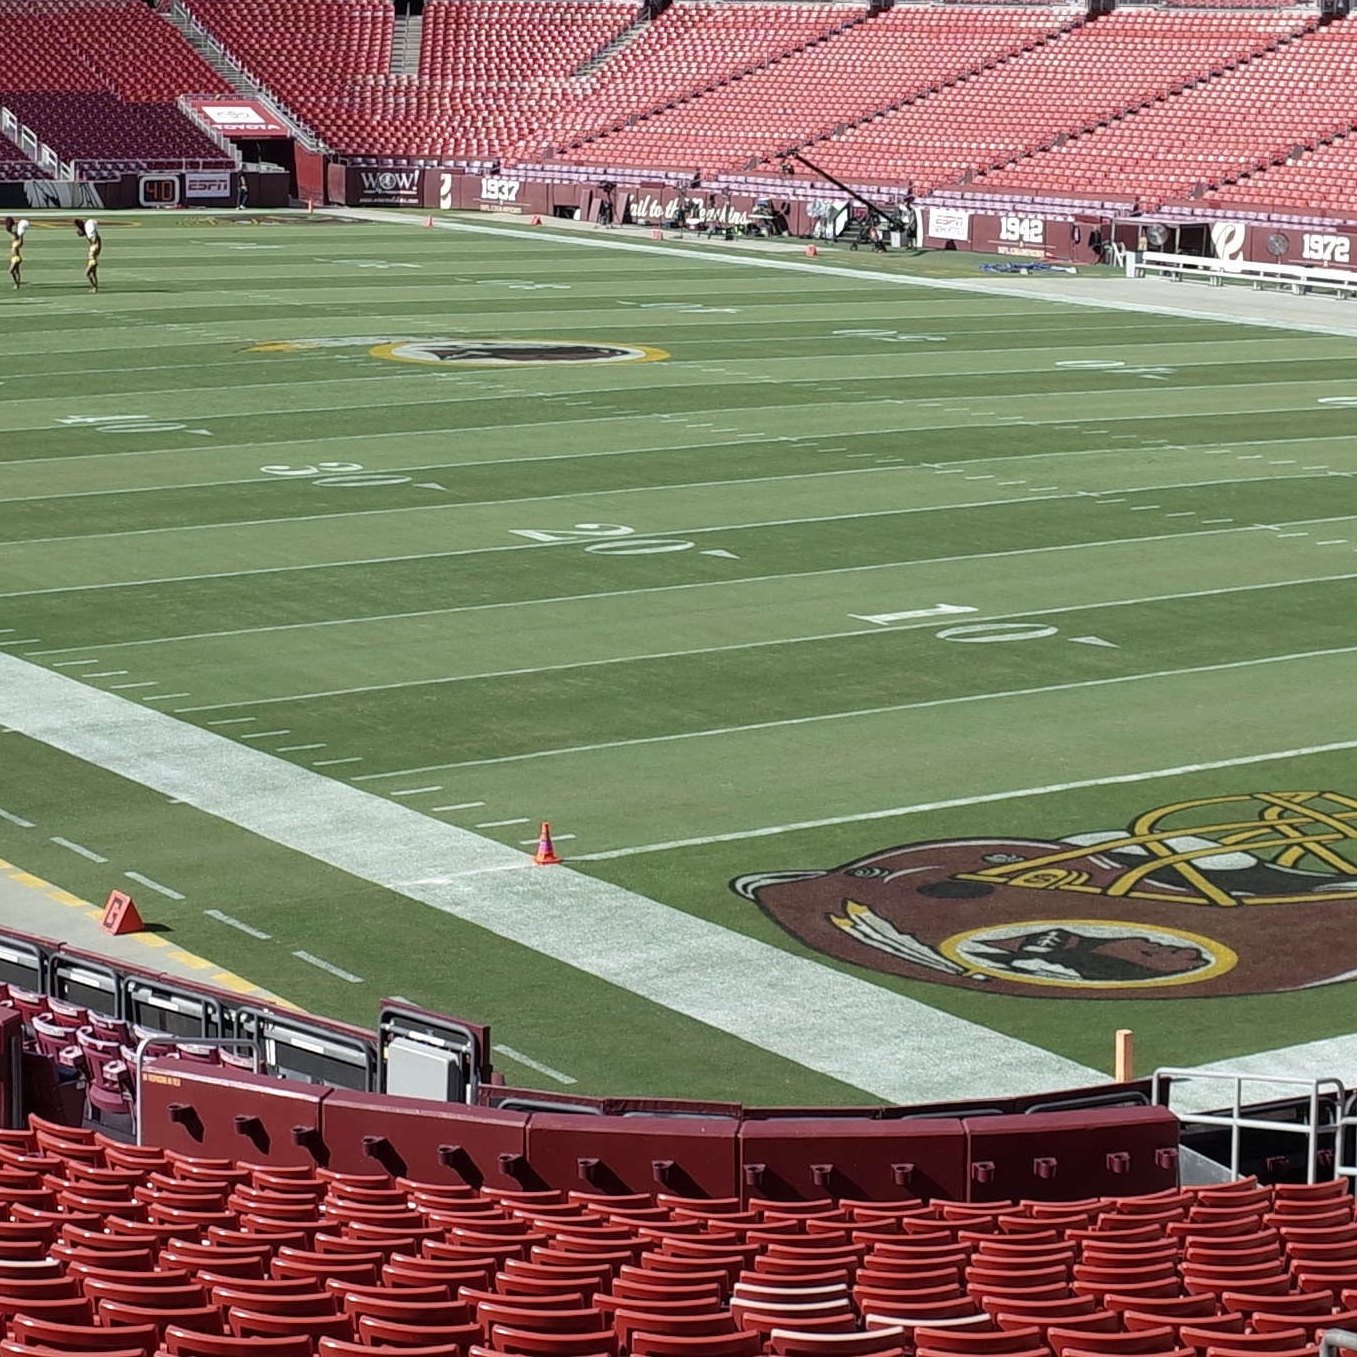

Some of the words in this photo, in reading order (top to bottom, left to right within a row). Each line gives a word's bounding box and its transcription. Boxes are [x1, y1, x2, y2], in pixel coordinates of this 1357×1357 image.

[212, 123, 281, 131] TOYOTA
[145, 180, 173, 201] 40
[188, 179, 229, 191] ESPN
[481, 177, 520, 201] 1937
[649, 200, 663, 217] to
[999, 217, 1044, 243] 1942
[1011, 246, 1045, 258] CHAMPIONS
[1302, 233, 1351, 262] 1972
[846, 602, 1059, 644] 10
[103, 896, 124, 929] G
